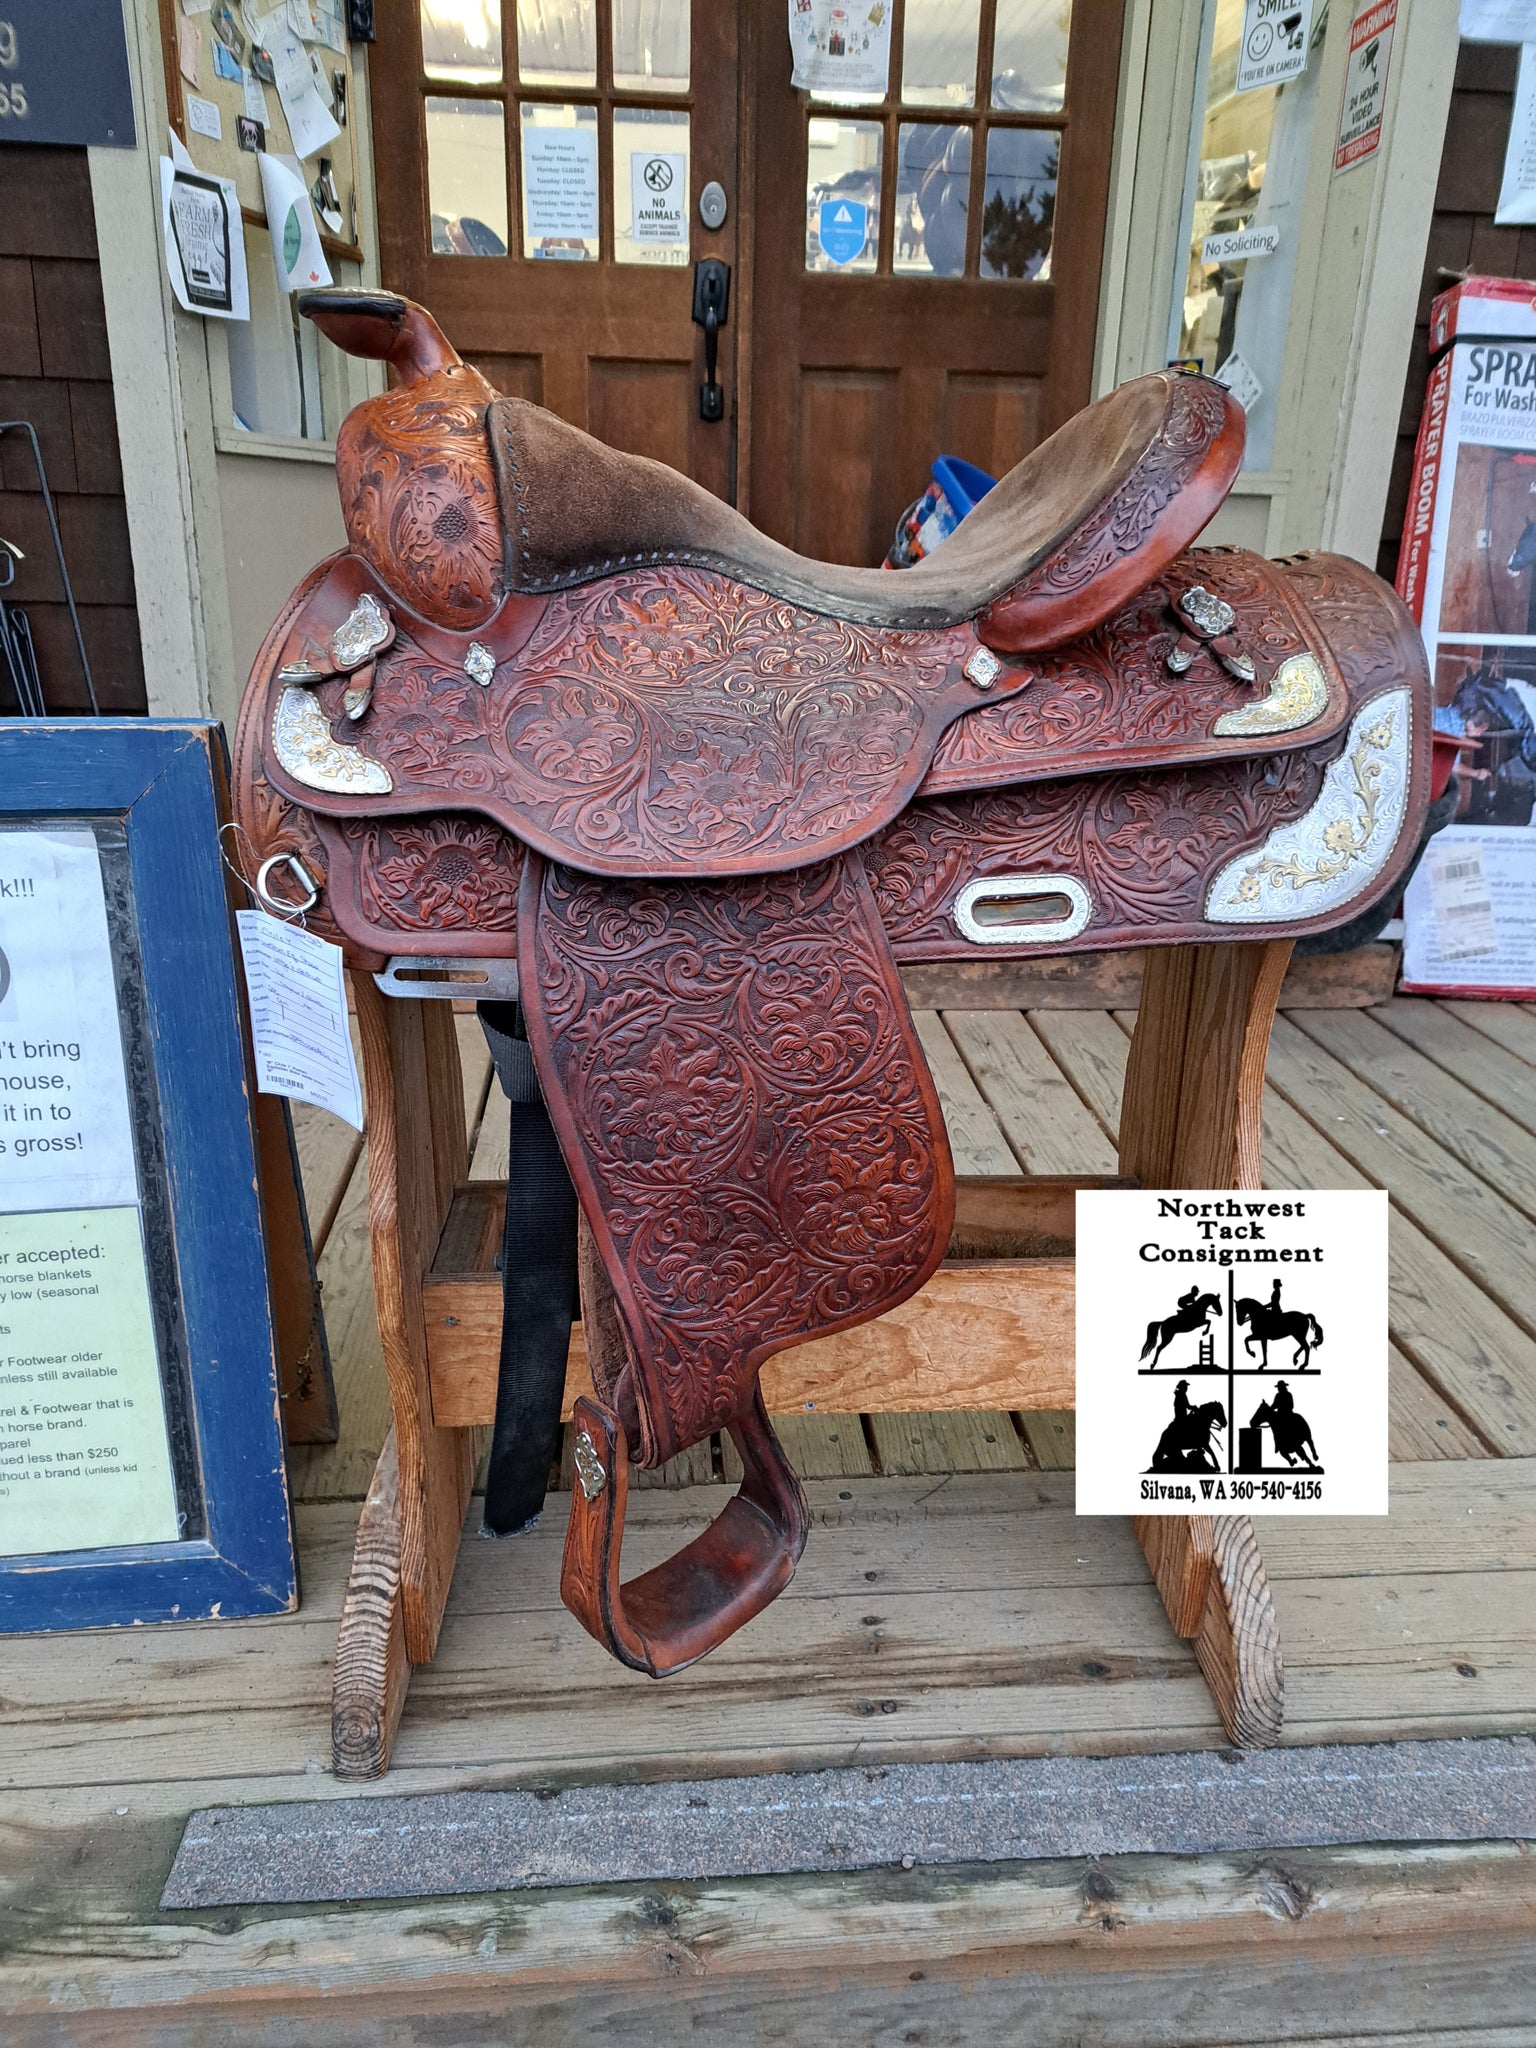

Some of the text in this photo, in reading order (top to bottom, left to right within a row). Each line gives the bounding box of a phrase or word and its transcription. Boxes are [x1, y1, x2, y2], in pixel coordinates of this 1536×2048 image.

[1257, 0, 1302, 18] SMIL
[1353, 2, 1397, 43] WARNING
[1266, 63, 1275, 76] ON
[1276, 57, 1302, 73] CAMERA
[1360, 81, 1379, 104] HOUR
[1352, 101, 1373, 125] VIDEO
[1340, 112, 1382, 146] SURVEILLANCE
[561, 166, 585, 174] CLOSED
[178, 202, 211, 223] FARM
[652, 198, 666, 208] NO
[638, 210, 681, 220] ANIMALS
[179, 220, 212, 240] FRESH
[1205, 234, 1274, 257] No Soliciting
[1467, 347, 1536, 388] SPRA
[1464, 384, 1492, 407] For
[1425, 352, 1451, 460] SPRAYER
[1460, 410, 1490, 424] BRAZO
[1459, 424, 1496, 438] SPRAYER
[1498, 427, 1525, 440] BOOM
[1414, 462, 1436, 536] BOOM
[1411, 540, 1421, 562] For
[1405, 564, 1419, 603] Wash
[0, 878, 34, 898] k!!!
[0, 1040, 81, 1061] 't bring
[3, 1103, 71, 1121] it in to
[14, 1132, 83, 1157] gross!
[0, 1244, 106, 1264] r accepted:
[37, 1268, 92, 1281] blankets
[10, 1290, 33, 1300] low
[36, 1284, 99, 1300] (seasonal
[7, 1355, 68, 1367] Footwear
[71, 1351, 103, 1363] older
[37, 1370, 58, 1382] still
[62, 1366, 118, 1380] available
[0, 1397, 134, 1417] rel & Footwear that is
[8, 1422, 43, 1433] horse
[47, 1417, 87, 1430] brand.
[0, 1438, 31, 1451] parel
[28, 1453, 53, 1464] less
[56, 1451, 84, 1462] than
[87, 1446, 119, 1459] $250
[34, 1471, 41, 1479] a
[45, 1467, 81, 1479] brand
[84, 1465, 121, 1476] (unless
[123, 1463, 138, 1472] kid
